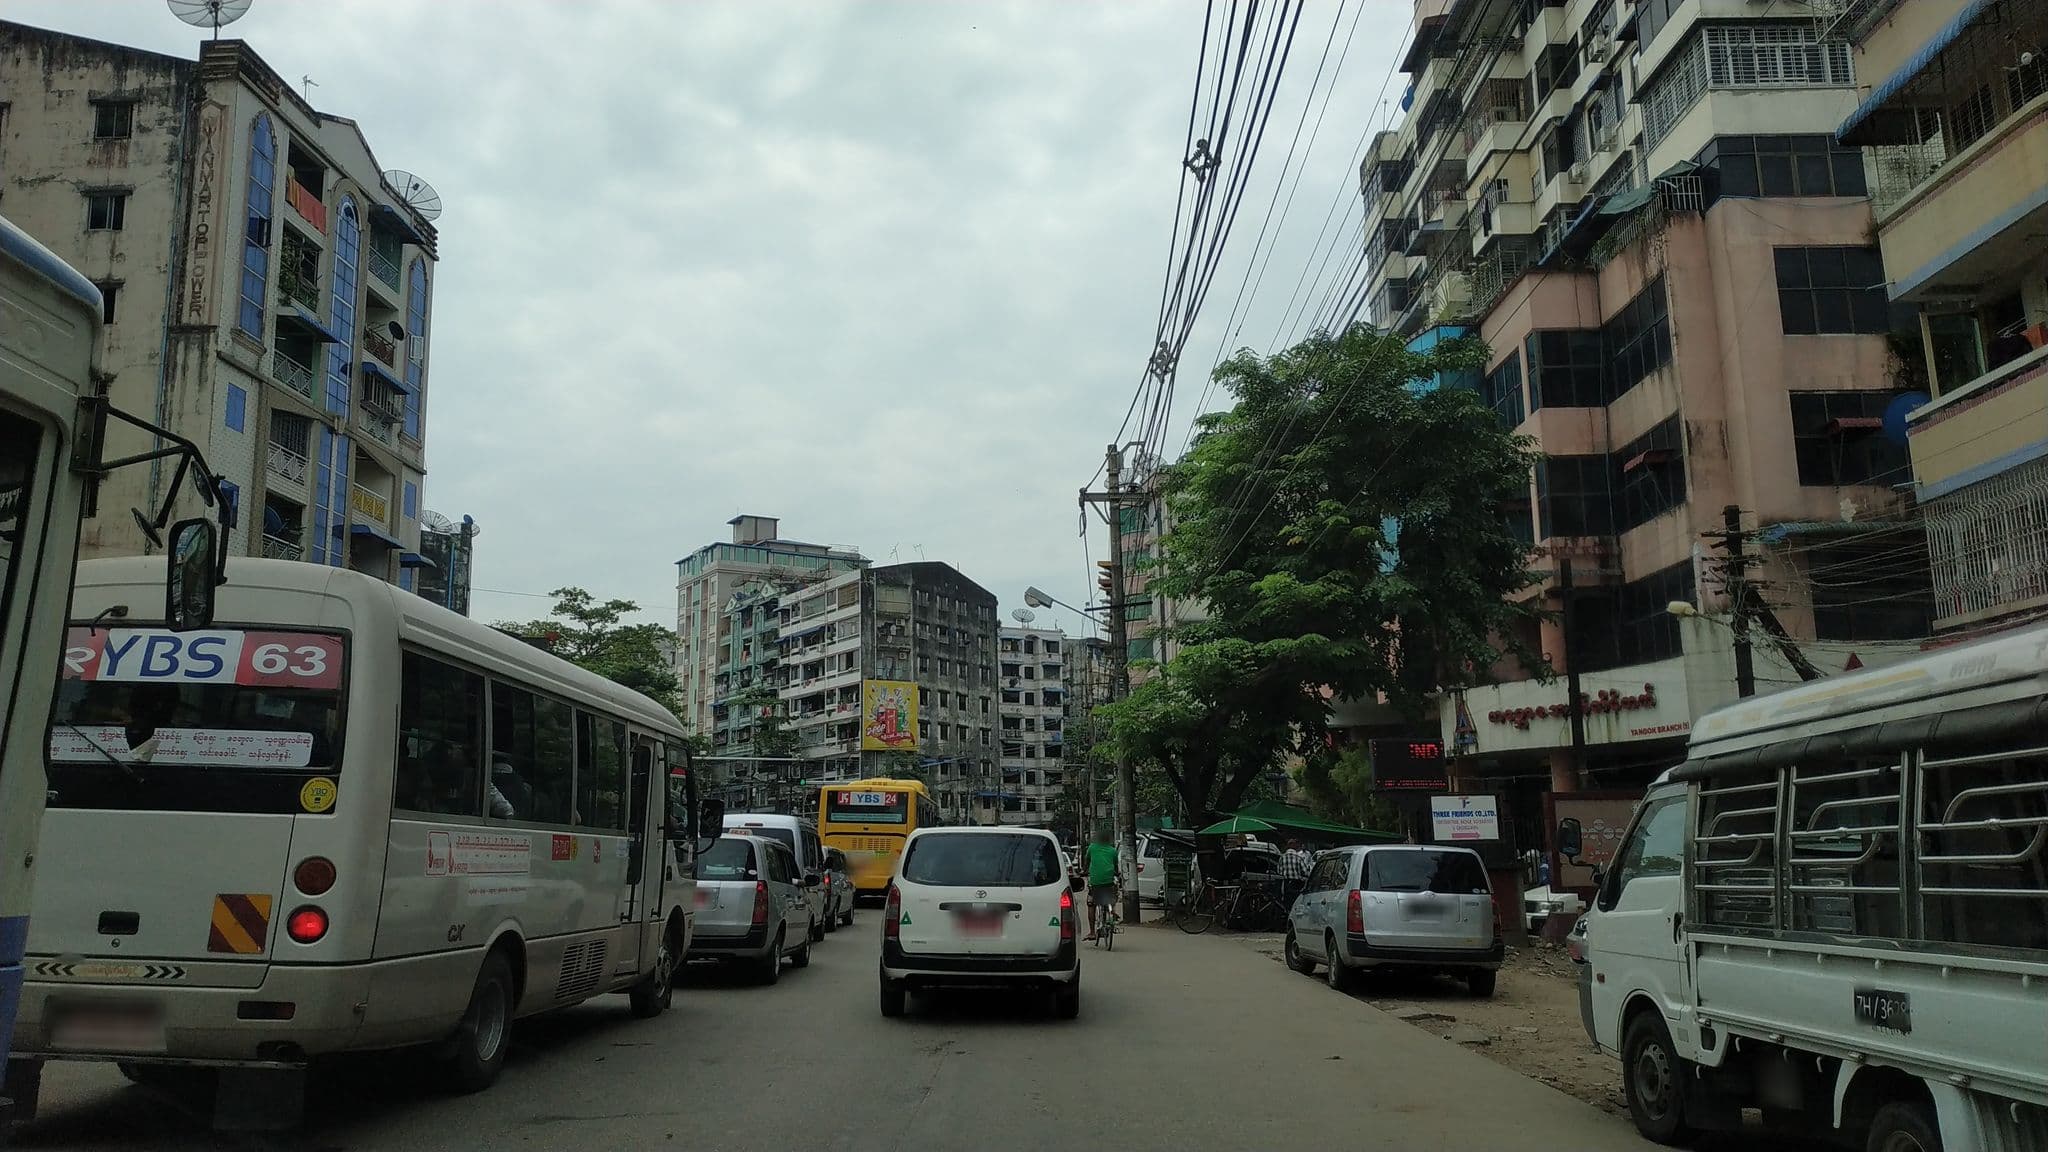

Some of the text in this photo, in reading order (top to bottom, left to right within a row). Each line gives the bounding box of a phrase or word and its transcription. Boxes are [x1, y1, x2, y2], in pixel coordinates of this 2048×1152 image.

[104, 634, 327, 679] YBS 63
[1630, 726, 1657, 736] YANGON
[1657, 723, 1682, 733] BRANCH
[857, 793, 897, 804] YBS 24
